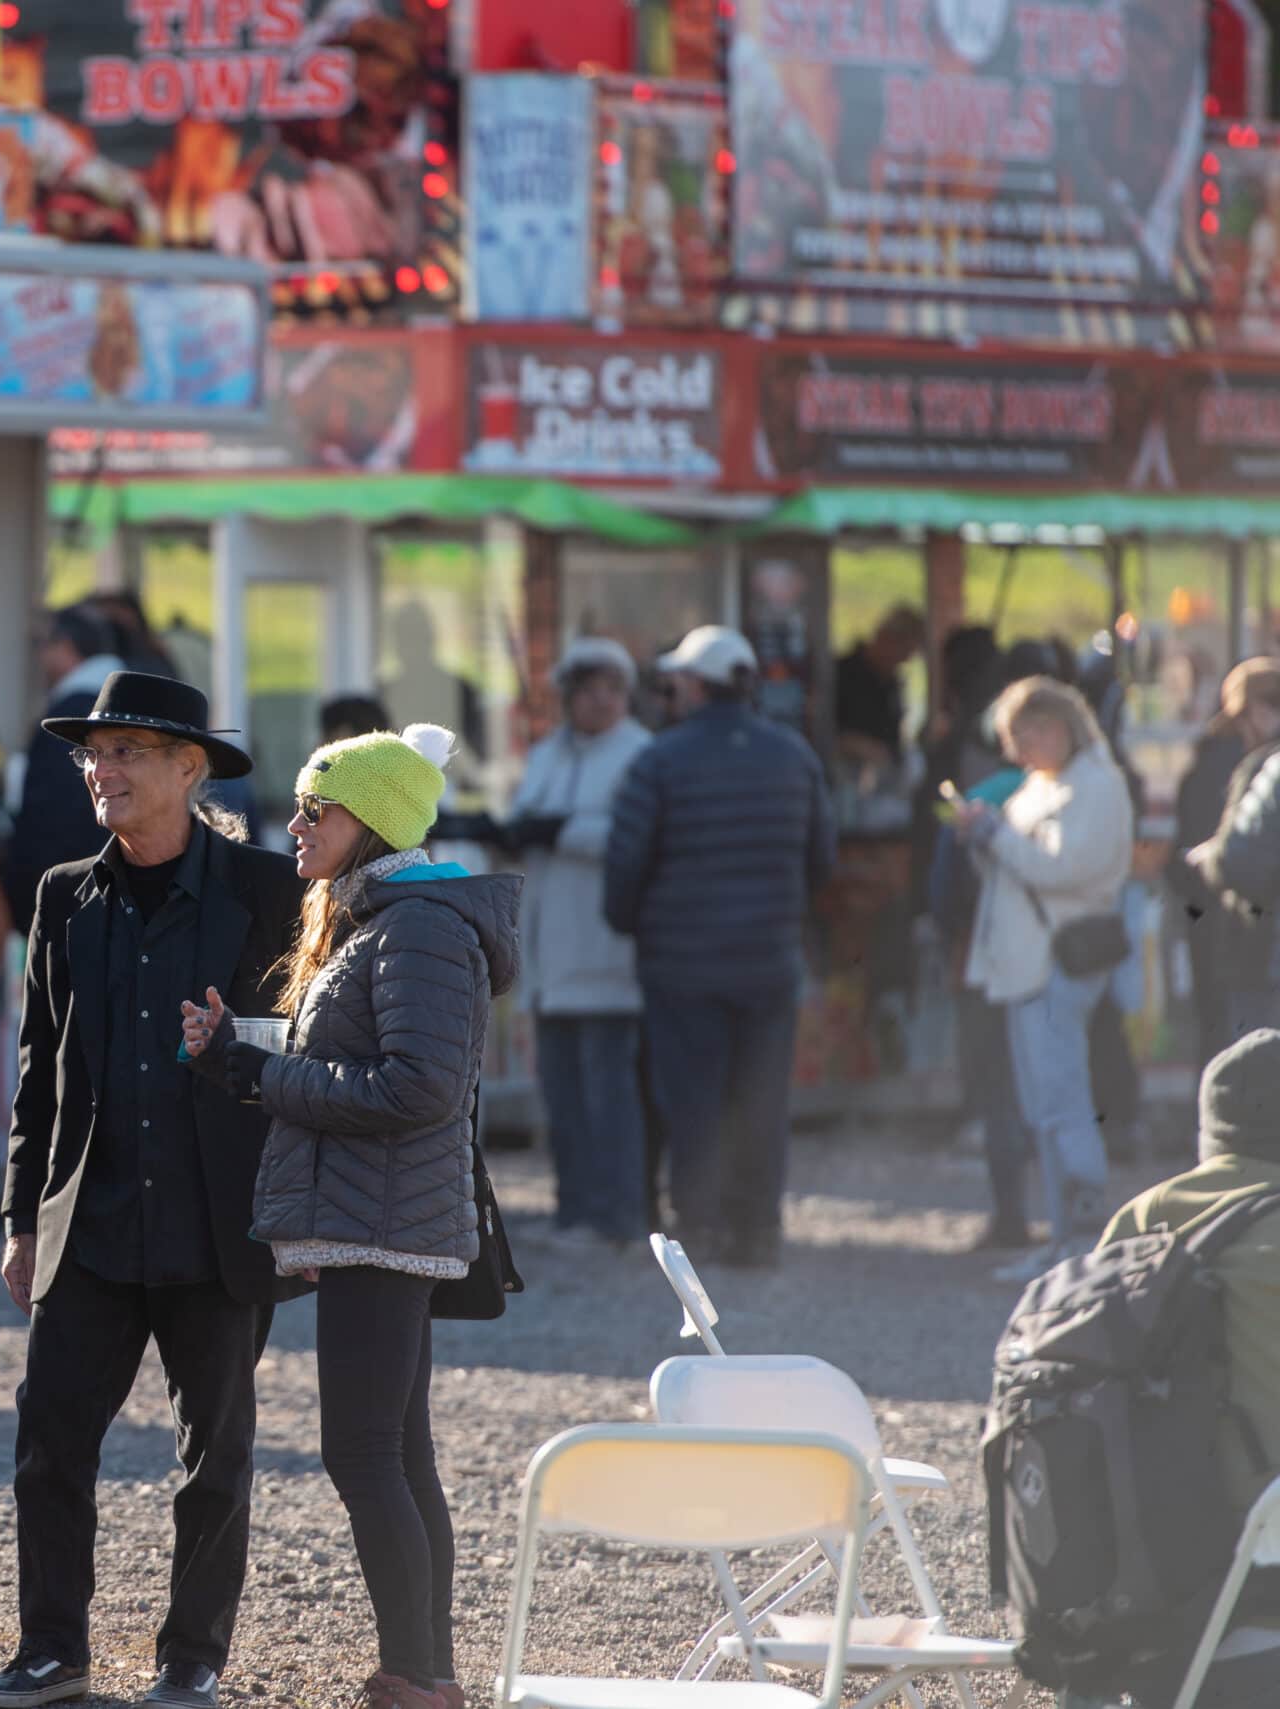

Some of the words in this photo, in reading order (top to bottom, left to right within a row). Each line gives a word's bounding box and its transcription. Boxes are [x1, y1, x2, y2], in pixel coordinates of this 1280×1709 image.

[128, 0, 306, 49] TIPS
[78, 47, 358, 124] BOWLS
[881, 72, 1056, 157] BOWLS
[520, 355, 594, 406] Ice
[601, 354, 712, 408] Cold
[532, 406, 686, 458] Drinks
